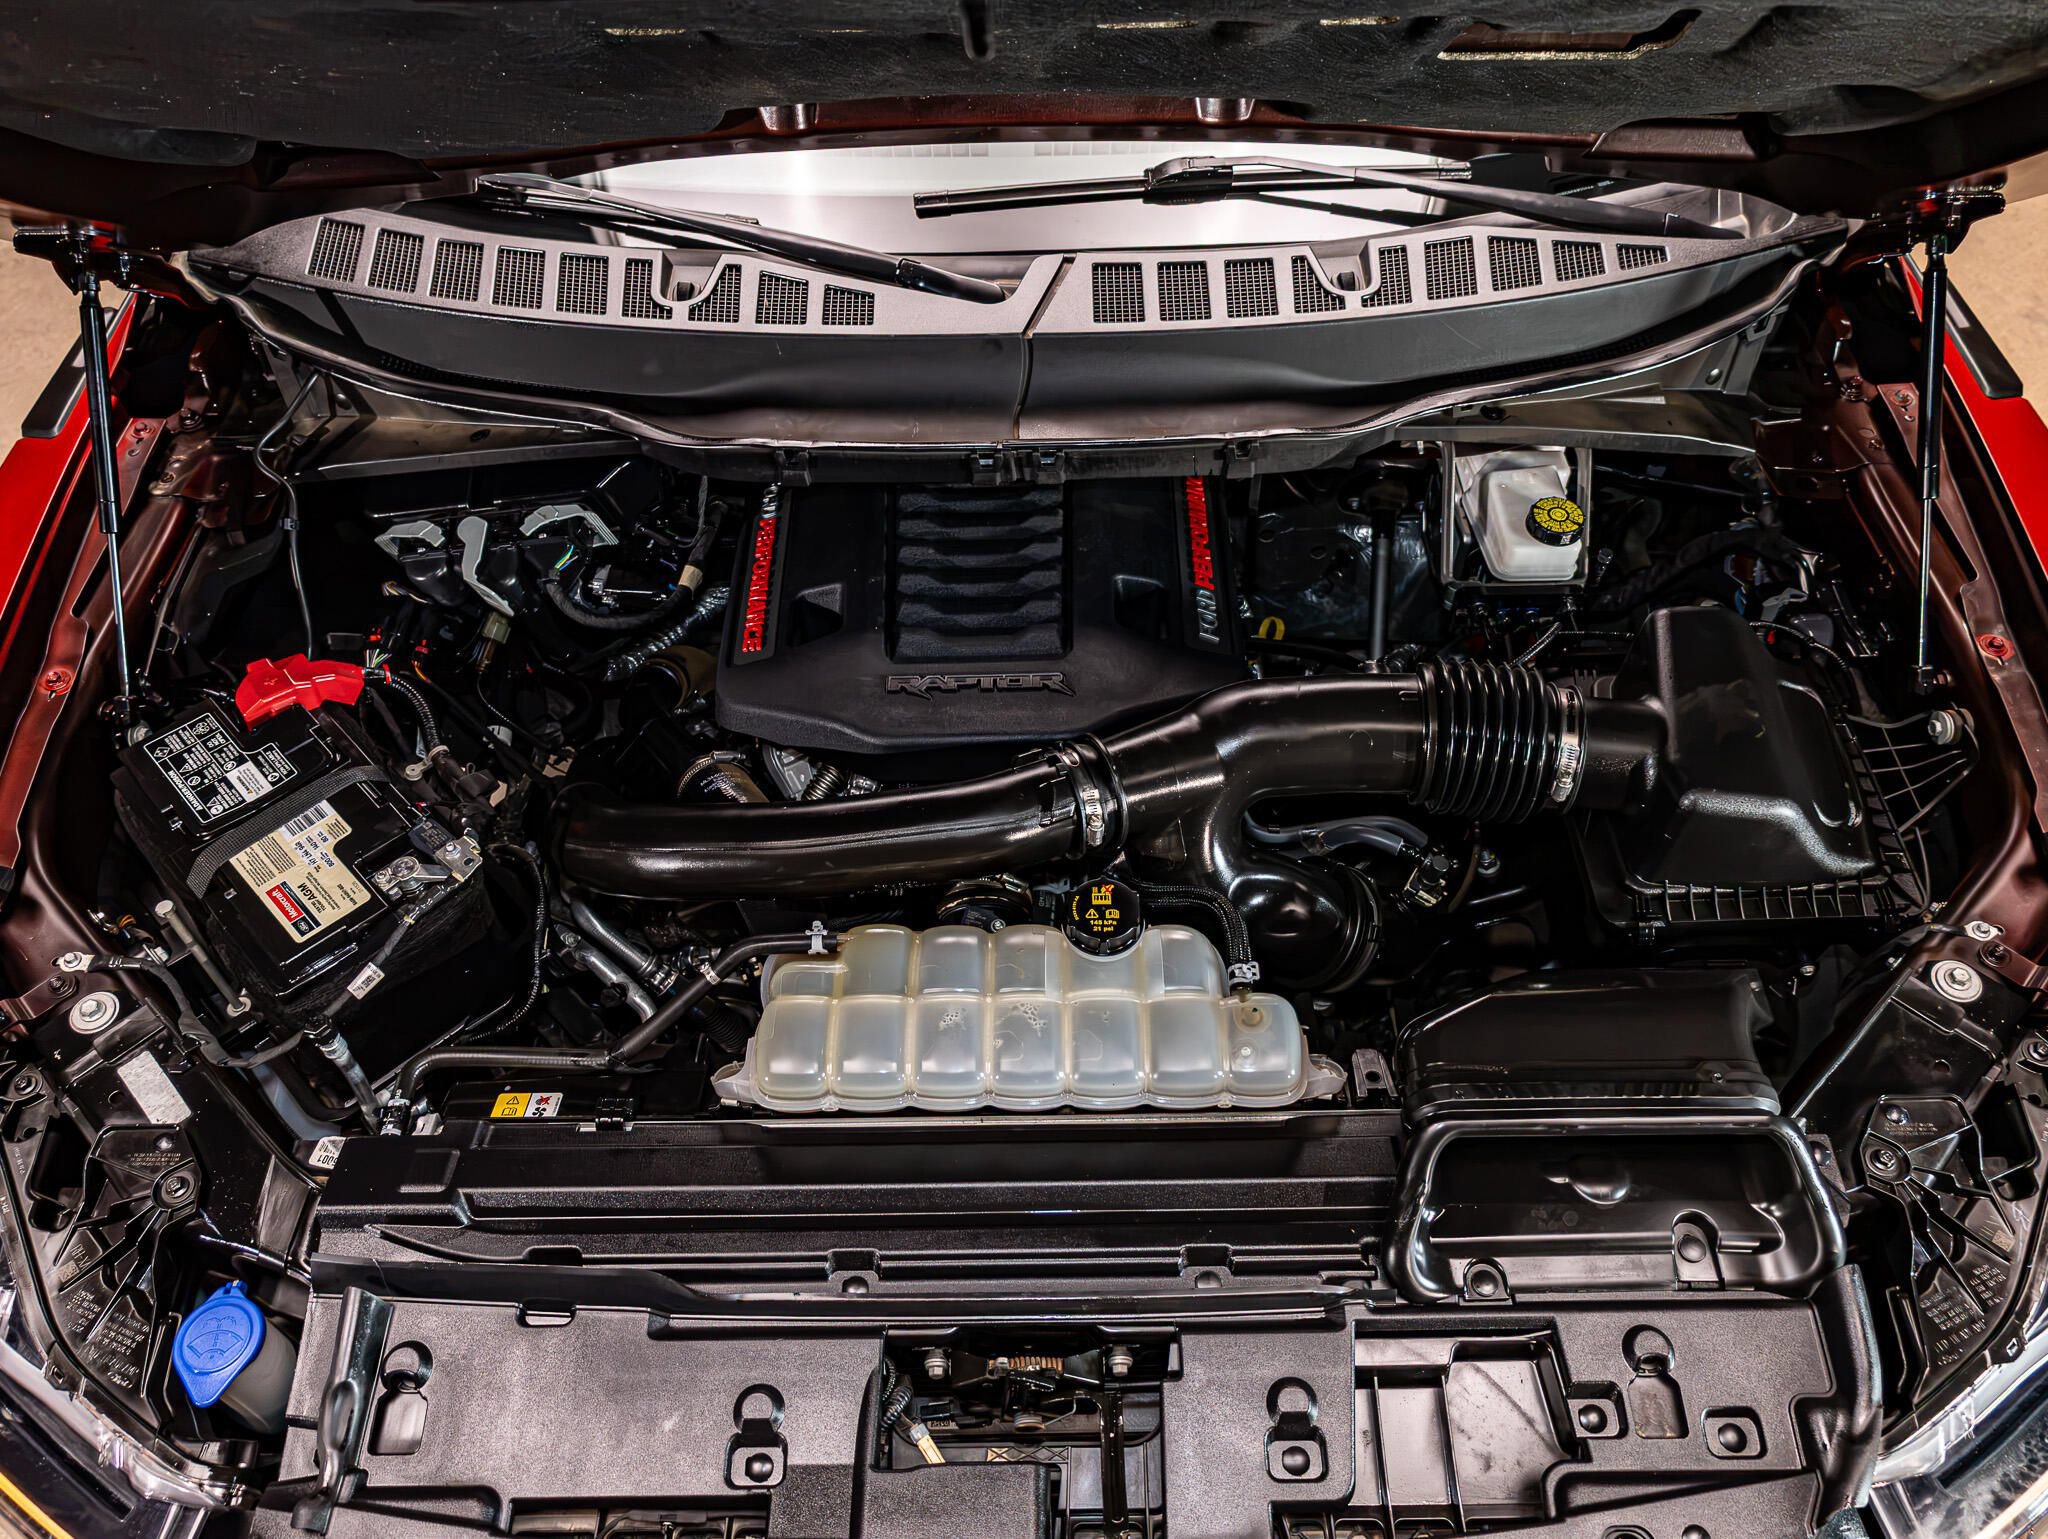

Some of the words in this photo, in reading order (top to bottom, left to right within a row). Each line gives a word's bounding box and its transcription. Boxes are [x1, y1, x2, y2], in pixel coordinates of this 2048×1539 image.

[761, 482, 782, 518] ORD
[742, 517, 777, 653] PERFORMANCE
[1196, 589, 1220, 644] FORD
[886, 672, 1077, 700] RAPTOR
[300, 847, 313, 860] LN4
[309, 839, 320, 851] 140
[323, 856, 335, 868] 800
[270, 887, 299, 920] Motorcraft
[296, 880, 317, 903] AGM
